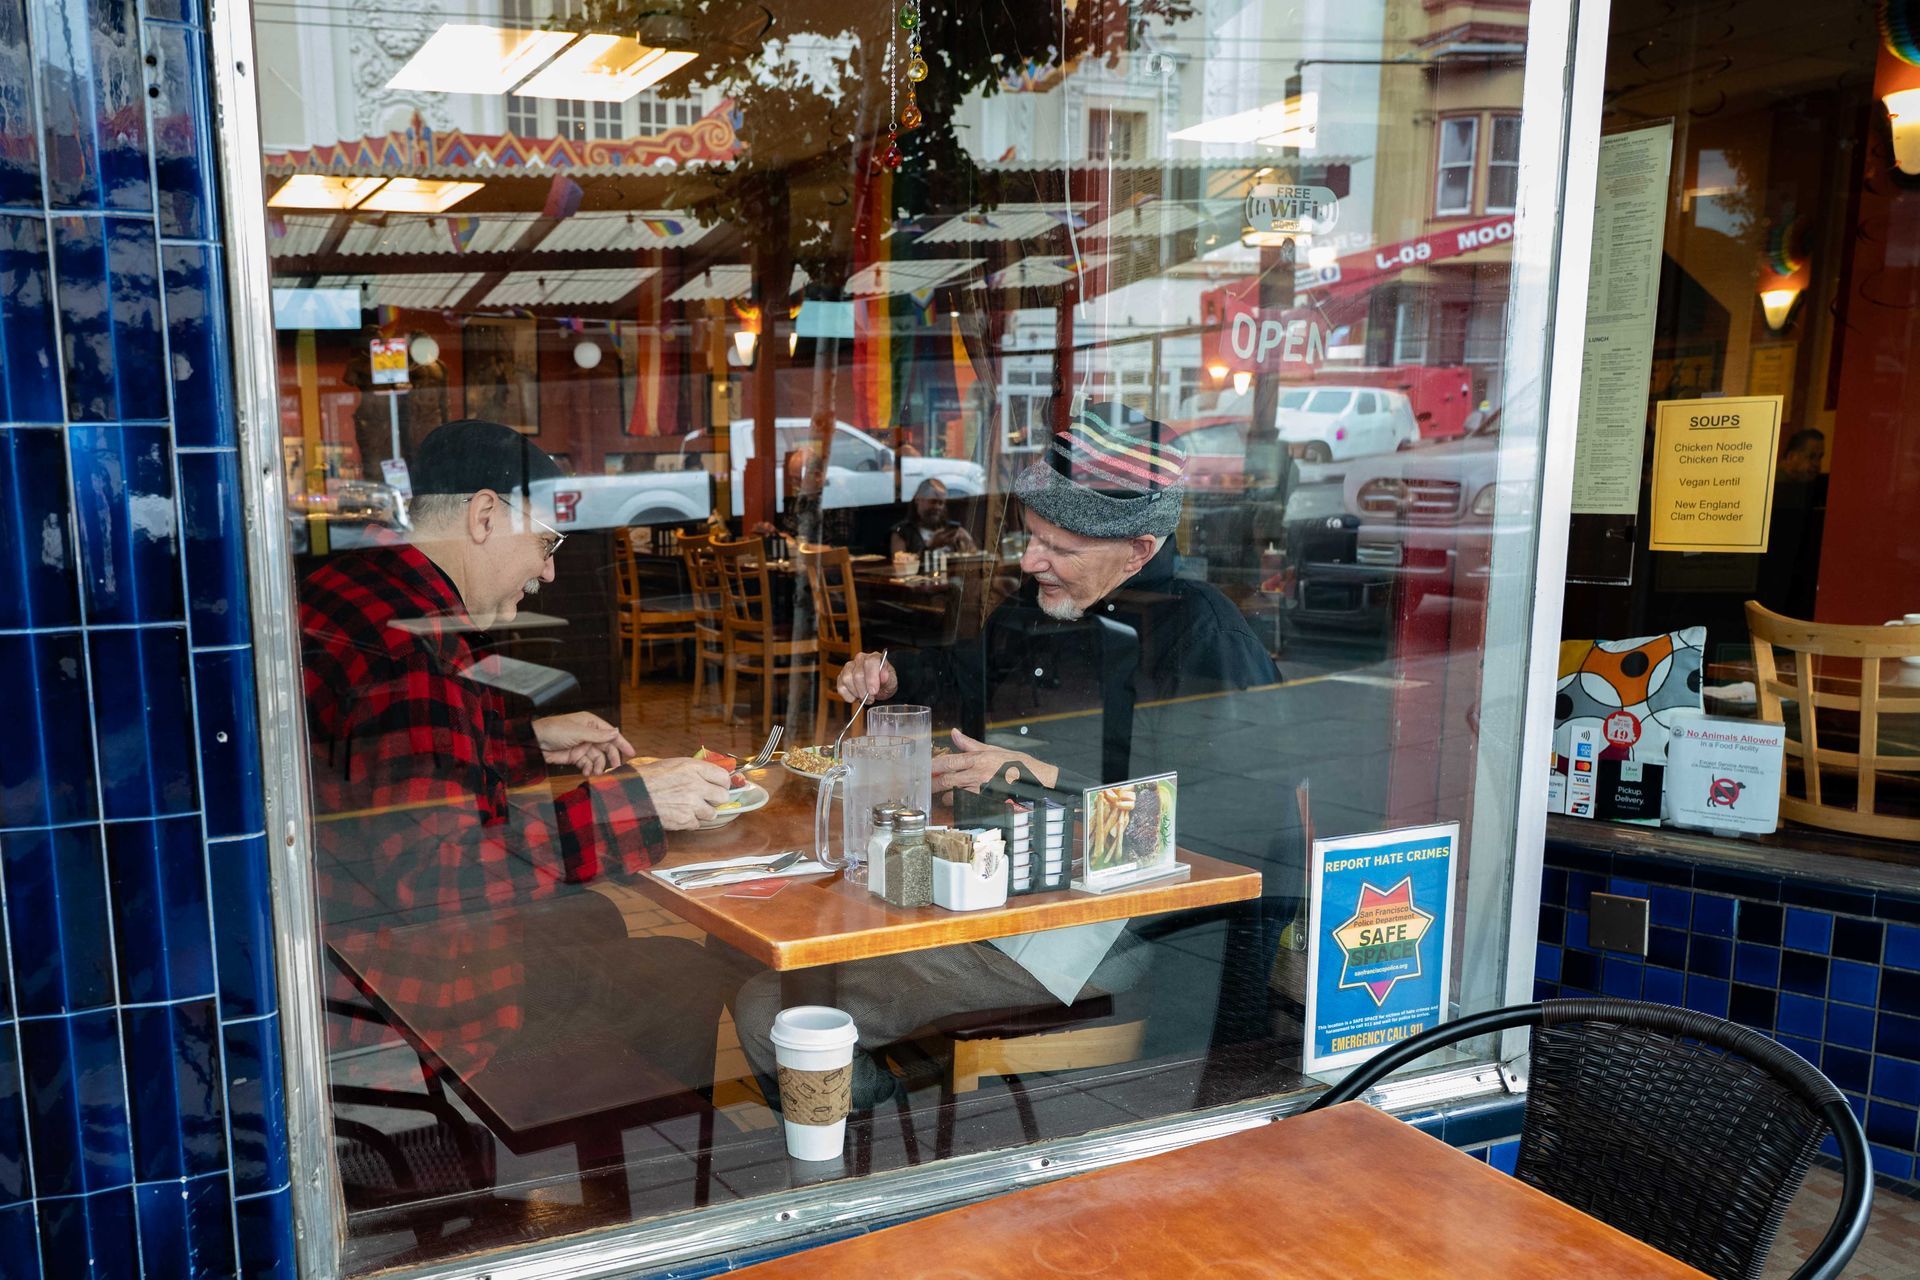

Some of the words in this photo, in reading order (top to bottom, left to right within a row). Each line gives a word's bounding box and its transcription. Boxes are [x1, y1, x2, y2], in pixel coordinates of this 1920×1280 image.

[1277, 187, 1311, 199] FREE
[1269, 199, 1318, 220] WiFi
[1231, 312, 1332, 364] OPEN
[1689, 415, 1740, 428] SOUPS
[1674, 443, 1713, 452] Chicken
[1716, 441, 1753, 451] Noodle
[1679, 455, 1718, 464] Chicken
[1721, 454, 1745, 463] Rice
[1679, 478, 1710, 488] Vegan
[1713, 477, 1740, 487] Lentil
[1675, 500, 1697, 509] New
[1700, 500, 1740, 511] England
[1670, 512, 1695, 521] Clam
[1698, 512, 1743, 521] Chowder
[1687, 729, 1699, 738] No
[1701, 731, 1738, 741] Animals
[1741, 735, 1778, 746] Allowed
[1715, 742, 1733, 750] Food
[1735, 744, 1760, 753] Facility
[1325, 857, 1371, 872] REPORT
[1374, 852, 1404, 866] HATE
[1406, 847, 1450, 862] CRIMES
[1360, 911, 1374, 919] San
[1375, 906, 1409, 916] Francisco
[1353, 919, 1374, 928] Police
[1375, 913, 1415, 926] Department
[1359, 924, 1407, 946] SAFE
[1350, 941, 1413, 967] SPACE
[1354, 963, 1409, 977] sanfranciscopolice.org
[1331, 1029, 1386, 1052] EMERGENCY
[1387, 1026, 1409, 1042] CALL
[1410, 1023, 1423, 1037] 911
